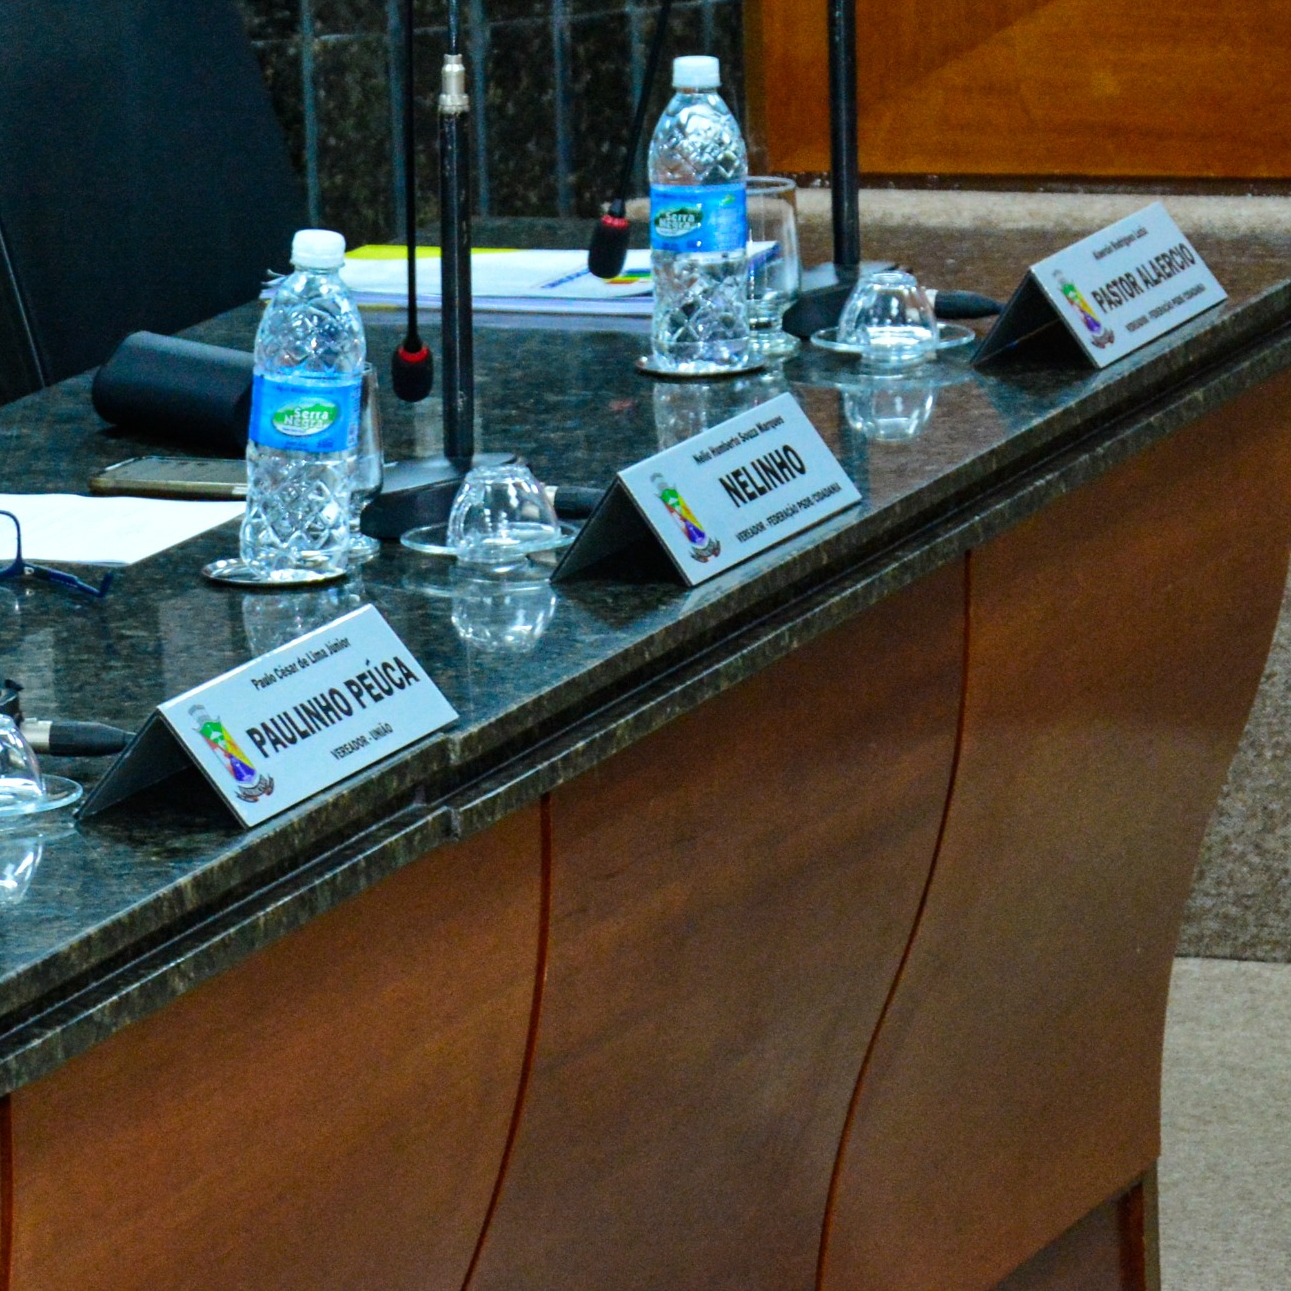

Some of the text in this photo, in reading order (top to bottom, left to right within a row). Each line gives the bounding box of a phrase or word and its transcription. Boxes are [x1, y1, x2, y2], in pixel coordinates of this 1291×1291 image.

[1091, 273, 1144, 313] PASTOR
[1136, 243, 1195, 289] ALAERCIO
[283, 414, 324, 430] Negra
[294, 407, 330, 421] Serra
[719, 445, 806, 508] NELINHO
[736, 521, 766, 543] VEREADOR
[251, 638, 350, 690] Paulo César de Lima Júnior
[246, 657, 420, 758] PAULINHO PEÚCA
[331, 736, 370, 760] VEREADOR
[369, 723, 393, 740] UNIÃO
